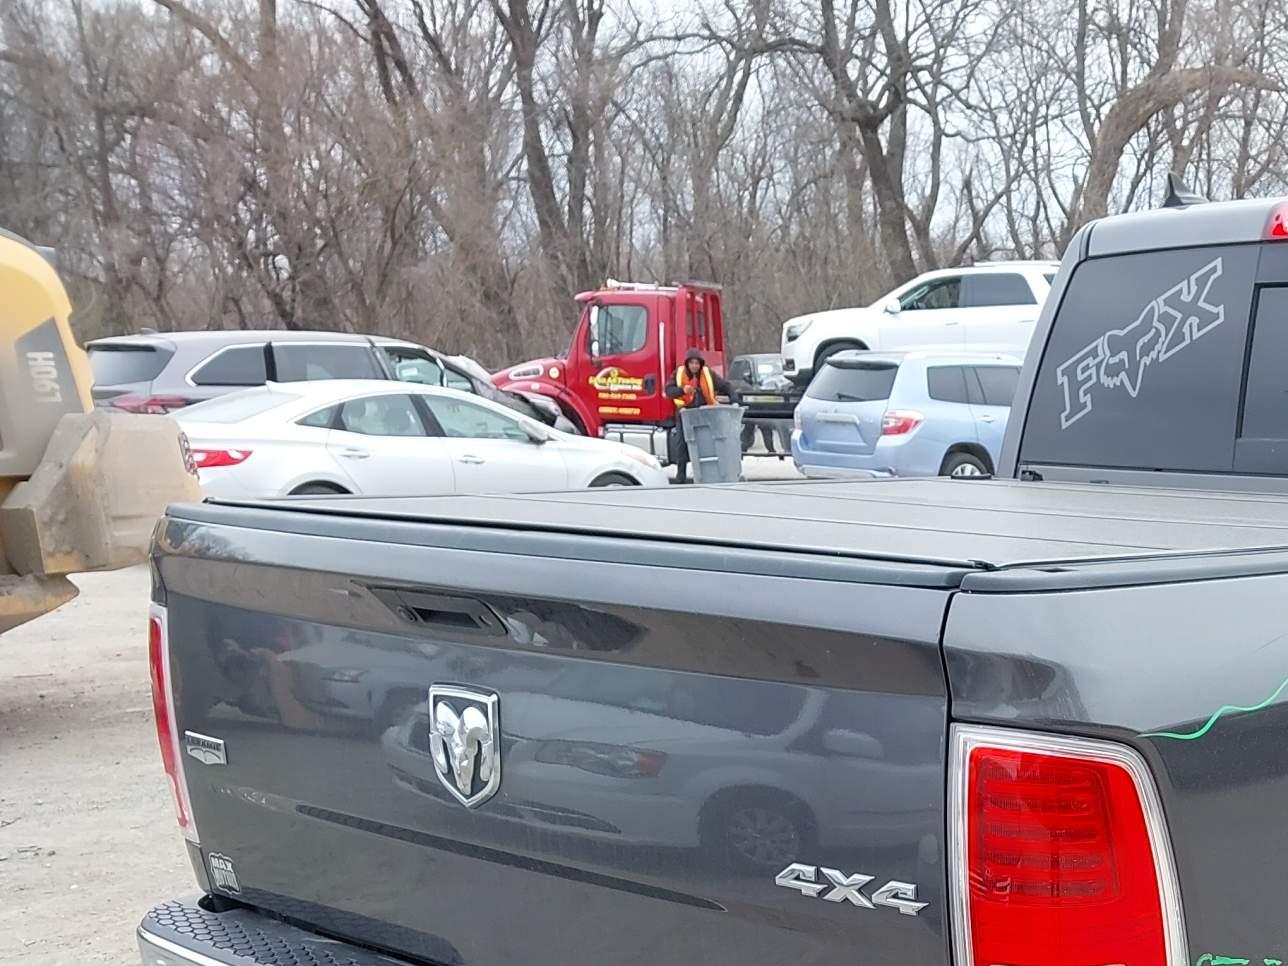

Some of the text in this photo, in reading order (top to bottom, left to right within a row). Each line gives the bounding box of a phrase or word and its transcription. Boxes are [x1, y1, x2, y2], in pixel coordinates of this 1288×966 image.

[1056, 256, 1225, 430] FOX
[26, 351, 62, 402] L90H
[210, 857, 233, 873] MAX
[775, 862, 930, 917] 4X4
